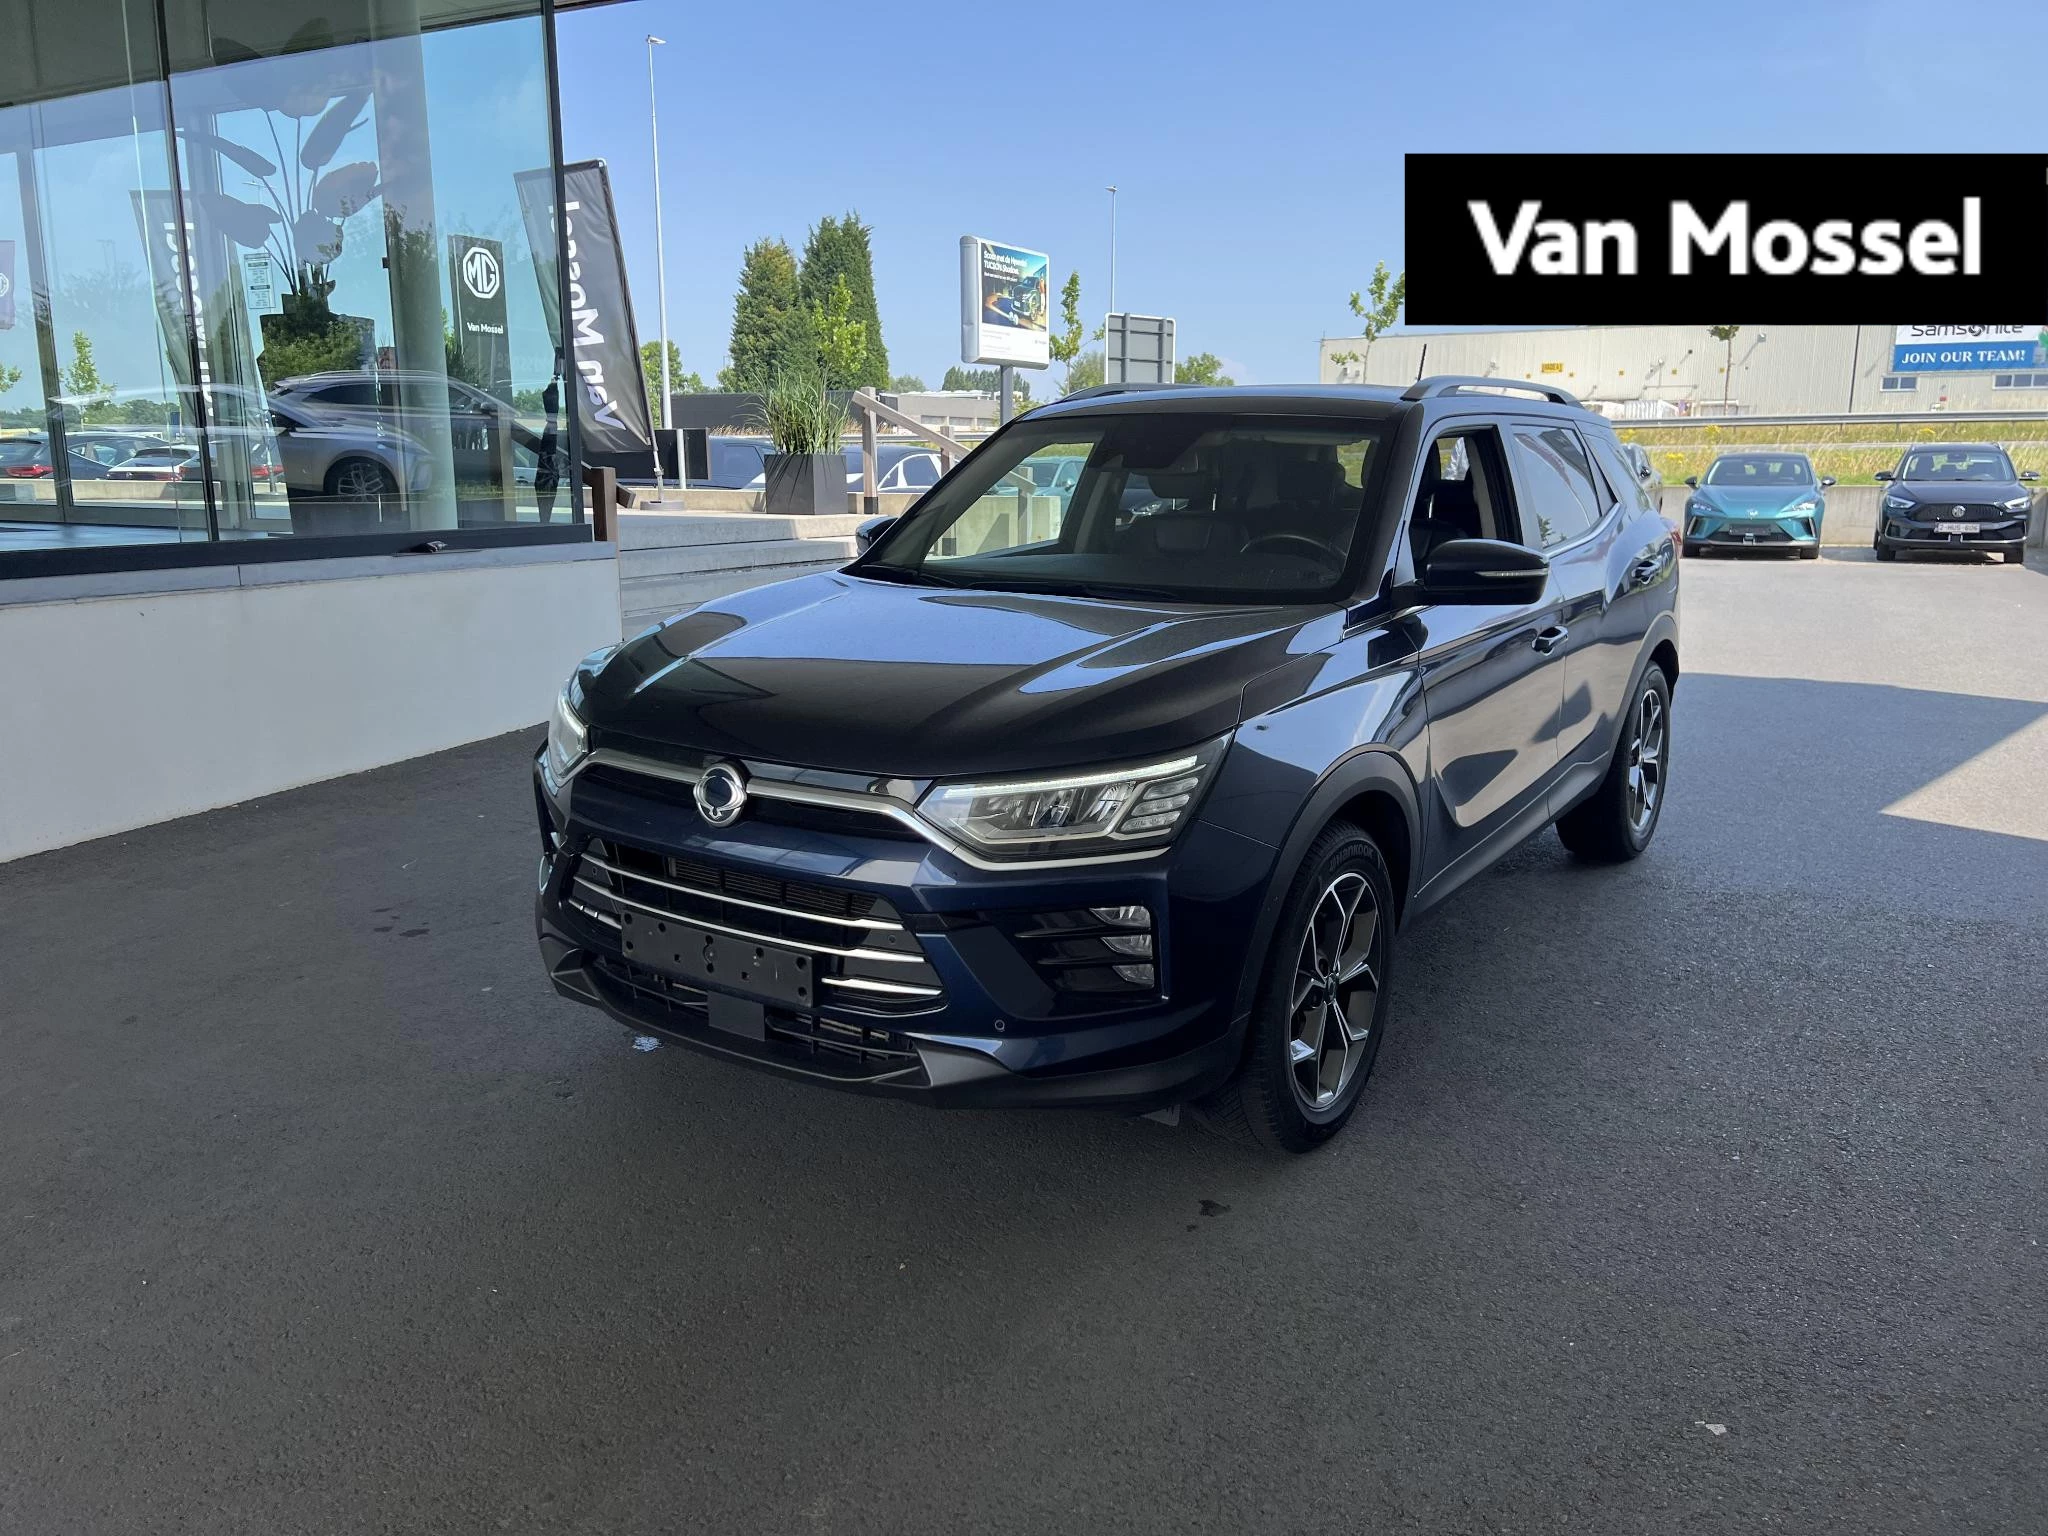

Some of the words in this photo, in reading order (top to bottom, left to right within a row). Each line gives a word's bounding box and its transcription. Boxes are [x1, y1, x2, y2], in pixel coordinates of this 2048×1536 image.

[466, 252, 496, 294] MG
[466, 322, 479, 332] Van
[480, 323, 504, 335] Mossel
[1901, 352, 1936, 364] JOIN
[1940, 351, 1972, 363] OUR
[1977, 349, 2026, 362] TEAM!
